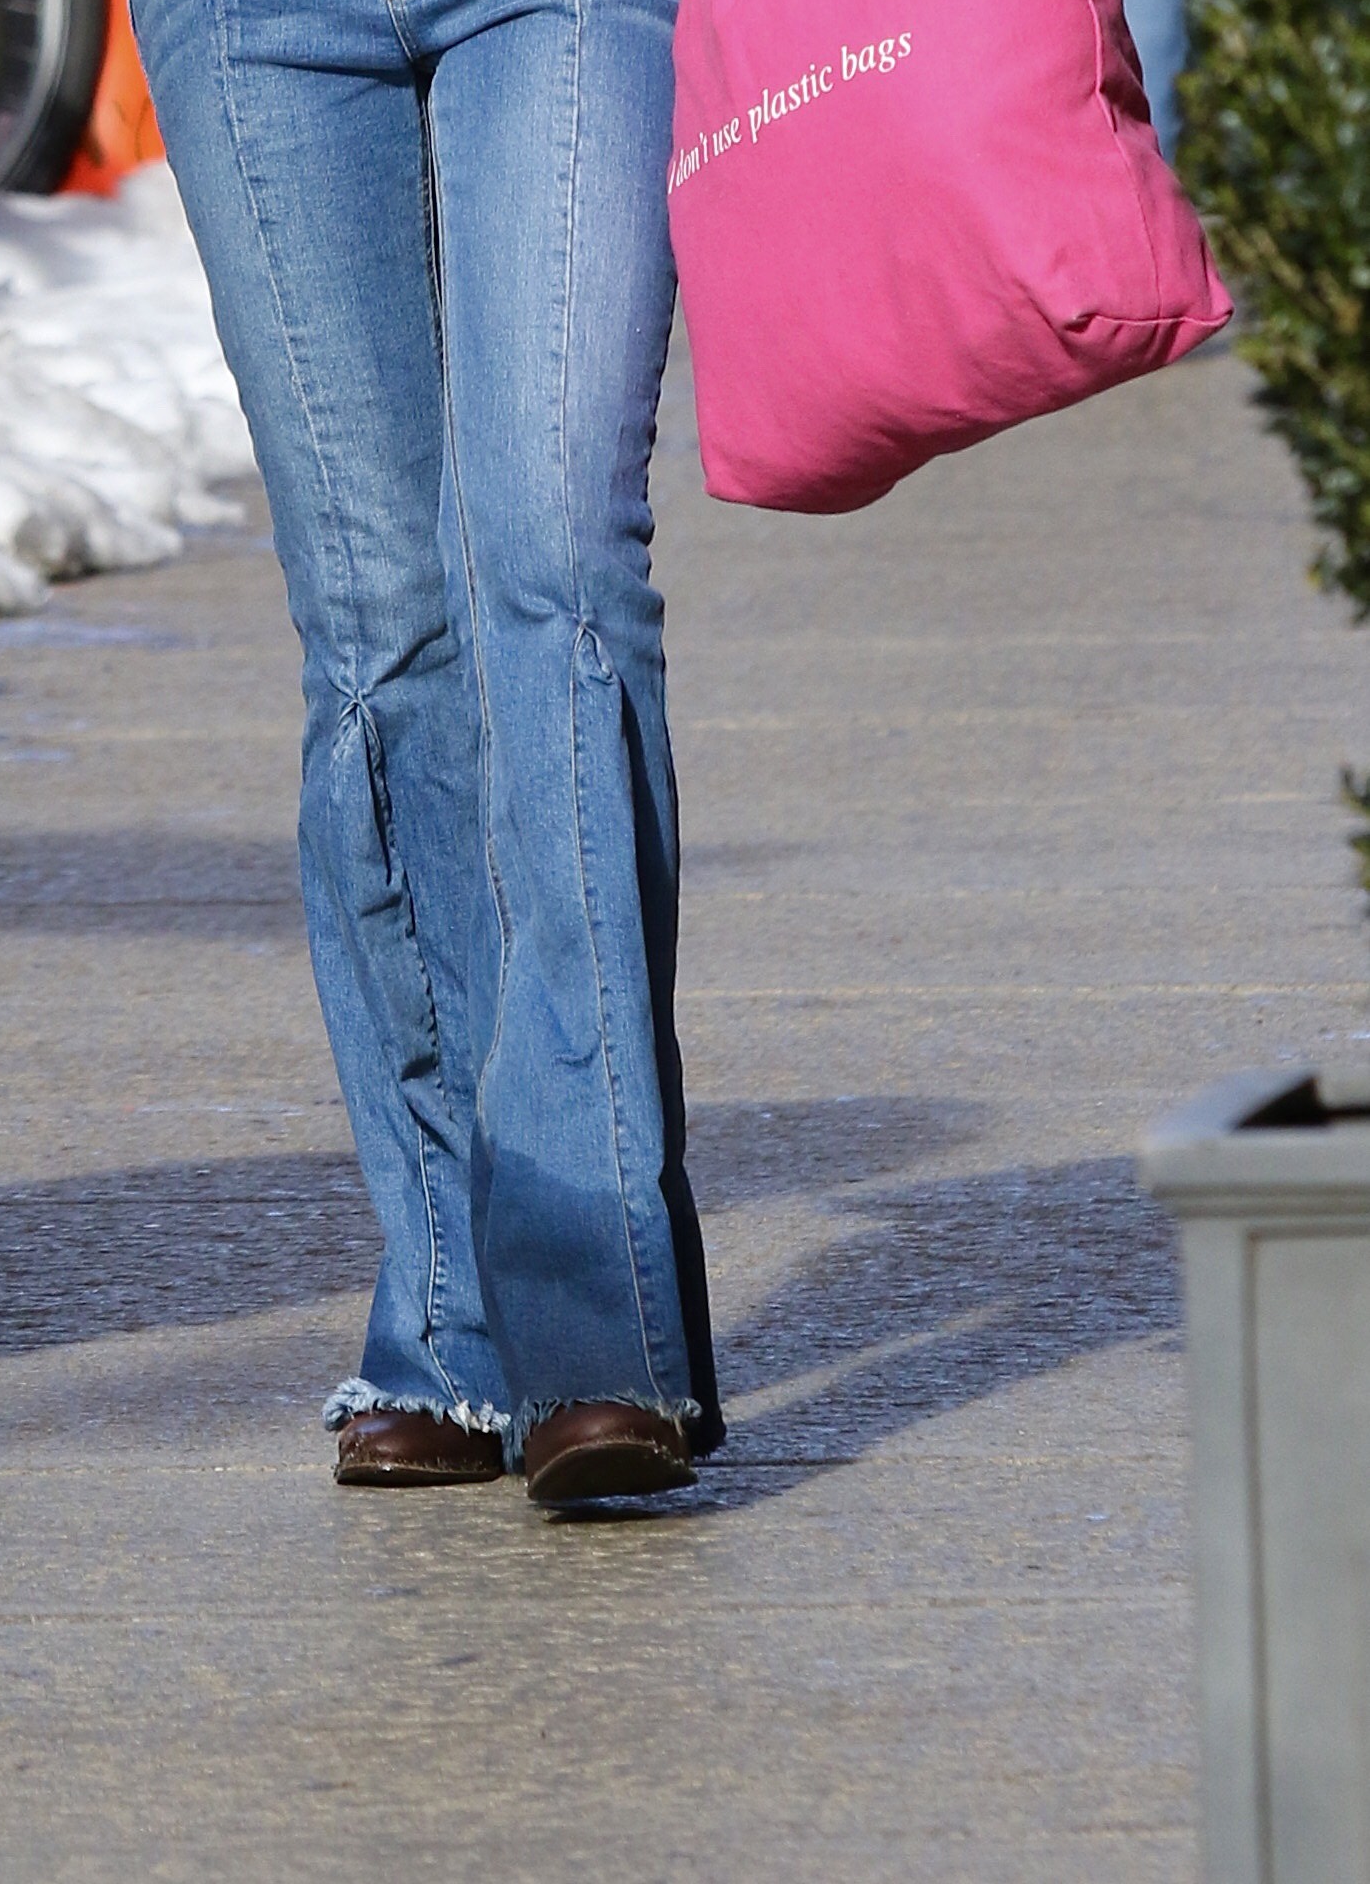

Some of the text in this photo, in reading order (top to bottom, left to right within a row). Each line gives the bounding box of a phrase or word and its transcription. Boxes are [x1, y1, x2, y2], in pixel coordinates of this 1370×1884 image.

[675, 132, 709, 187] don't
[712, 117, 743, 157] use
[747, 63, 834, 143] plastic
[841, 31, 912, 82] bags
